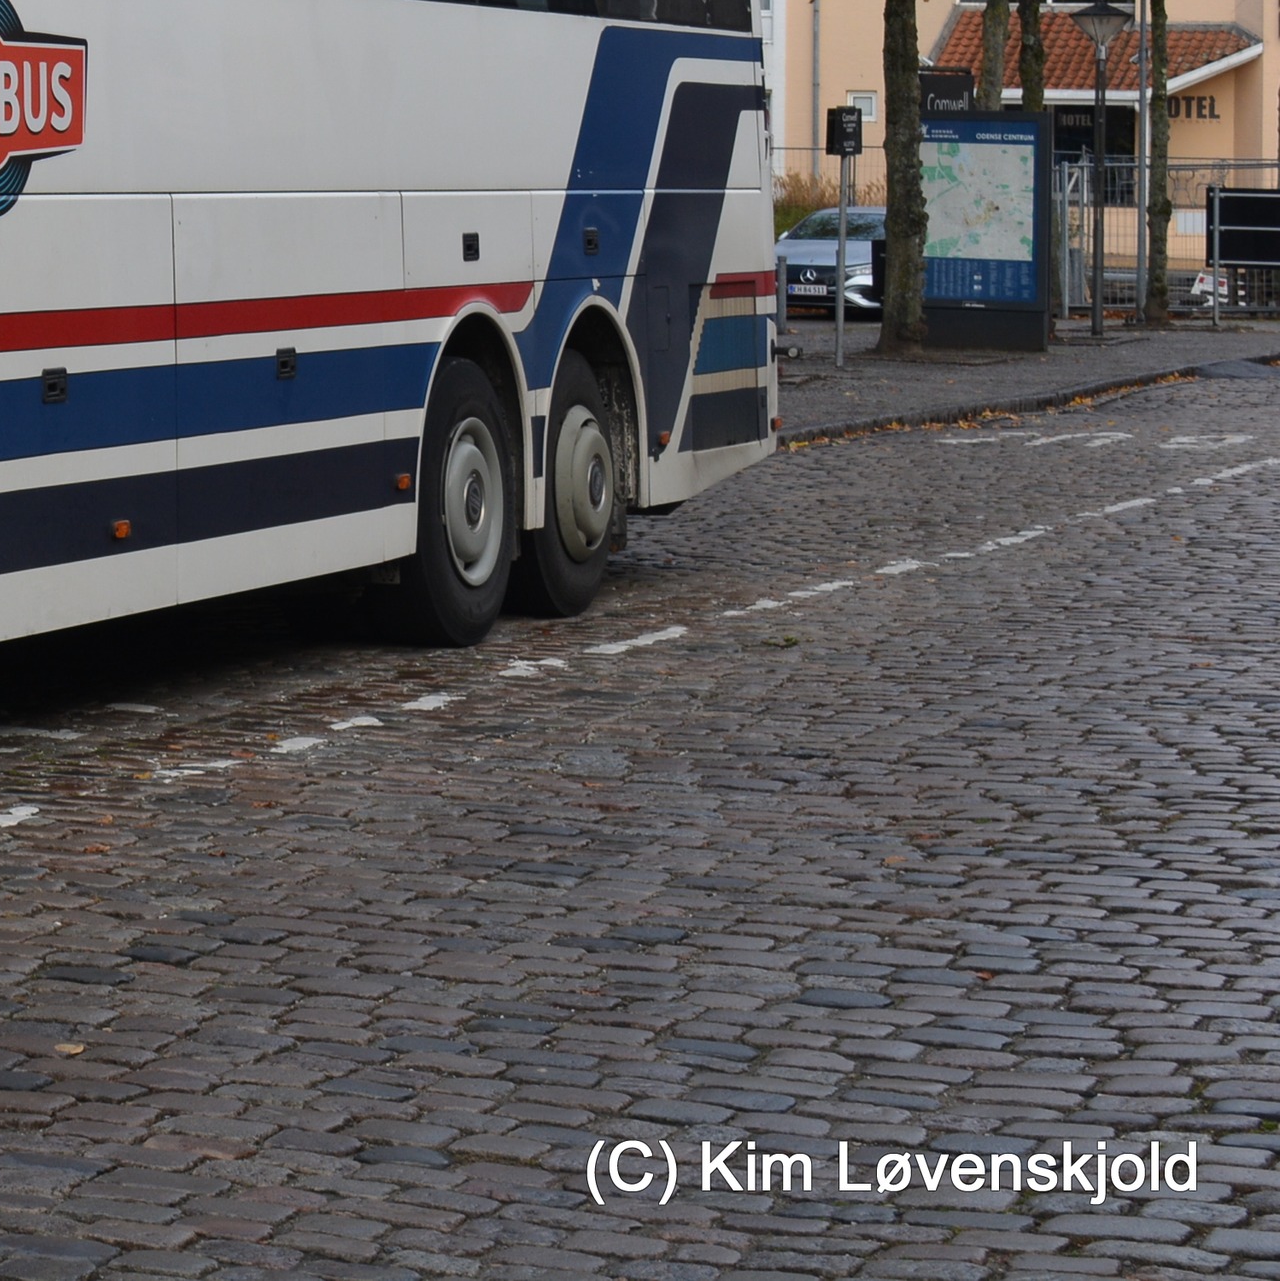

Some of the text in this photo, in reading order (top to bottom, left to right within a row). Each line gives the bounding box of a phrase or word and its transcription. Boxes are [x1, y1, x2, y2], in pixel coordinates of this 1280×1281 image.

[927, 91, 969, 111] Comwell
[1167, 95, 1221, 119] OTEL
[975, 132, 1035, 141] ODENSE CENTRUM
